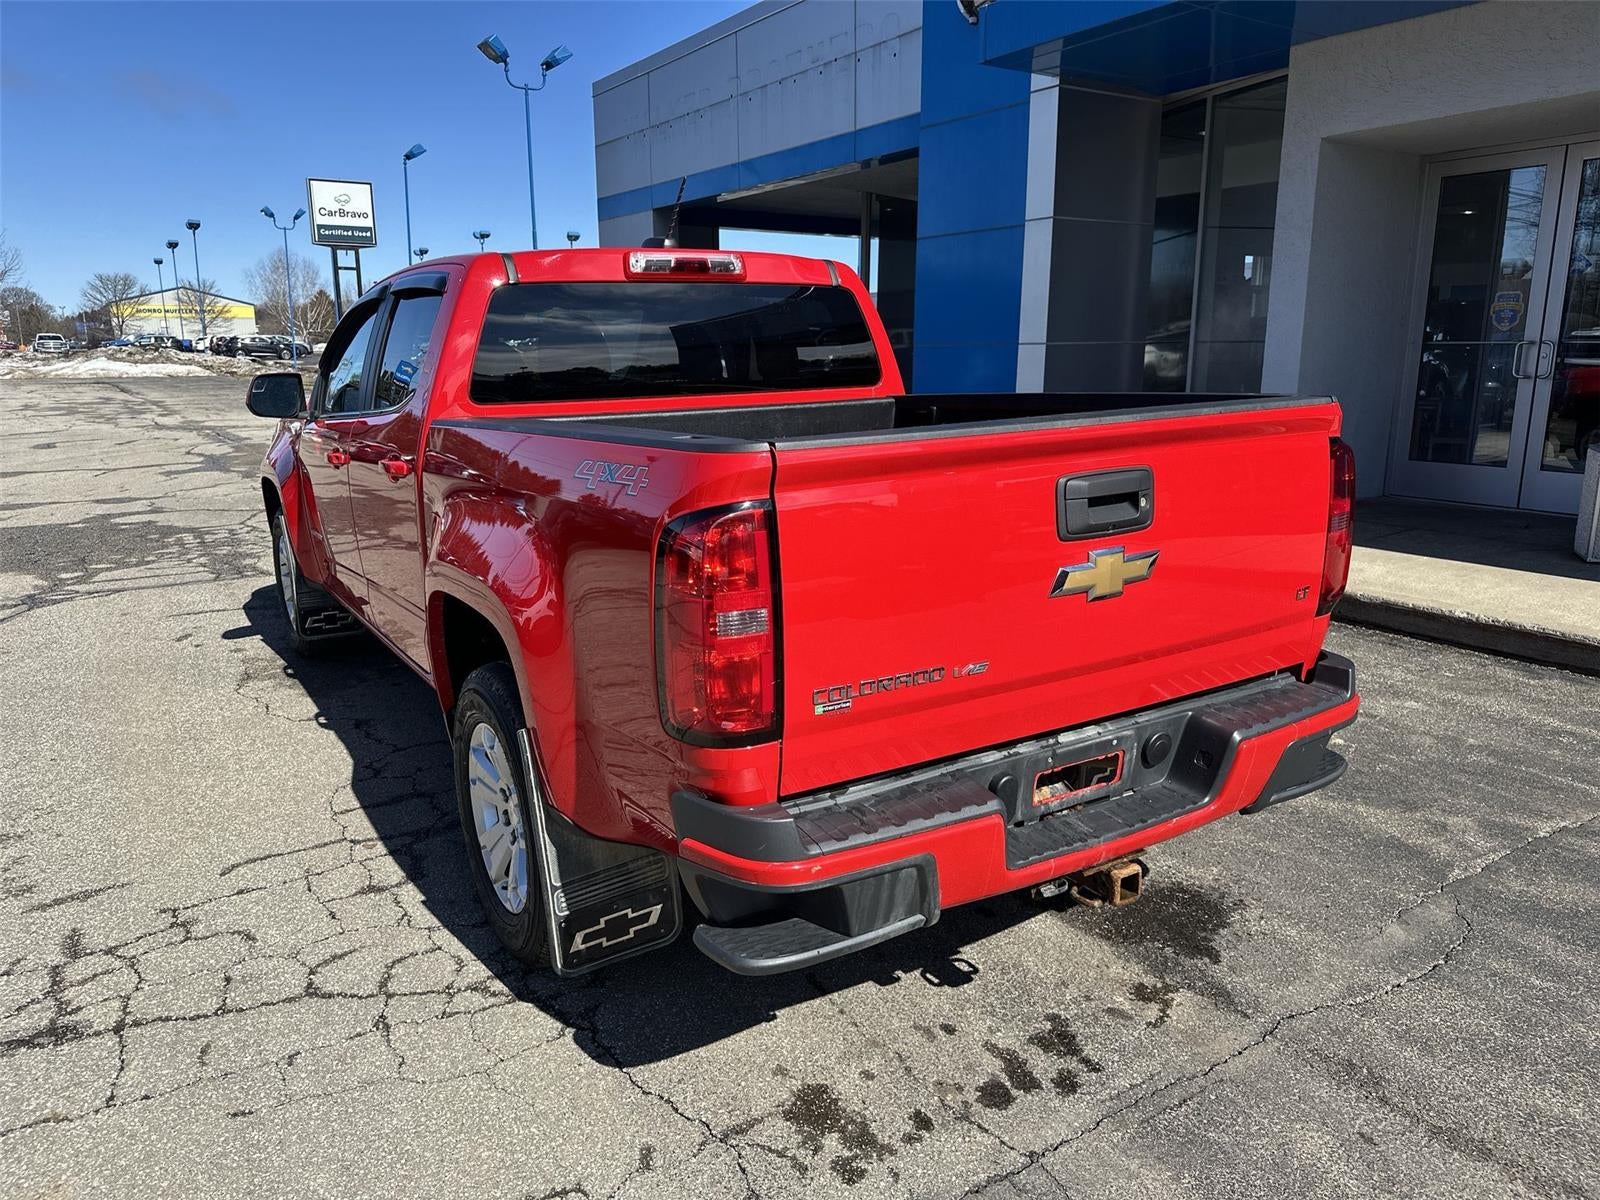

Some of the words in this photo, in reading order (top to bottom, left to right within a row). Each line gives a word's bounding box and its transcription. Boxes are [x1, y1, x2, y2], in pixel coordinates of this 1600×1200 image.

[318, 207, 369, 219] CarBravo
[320, 228, 352, 236] Certified
[812, 666, 945, 705] COLORADO
